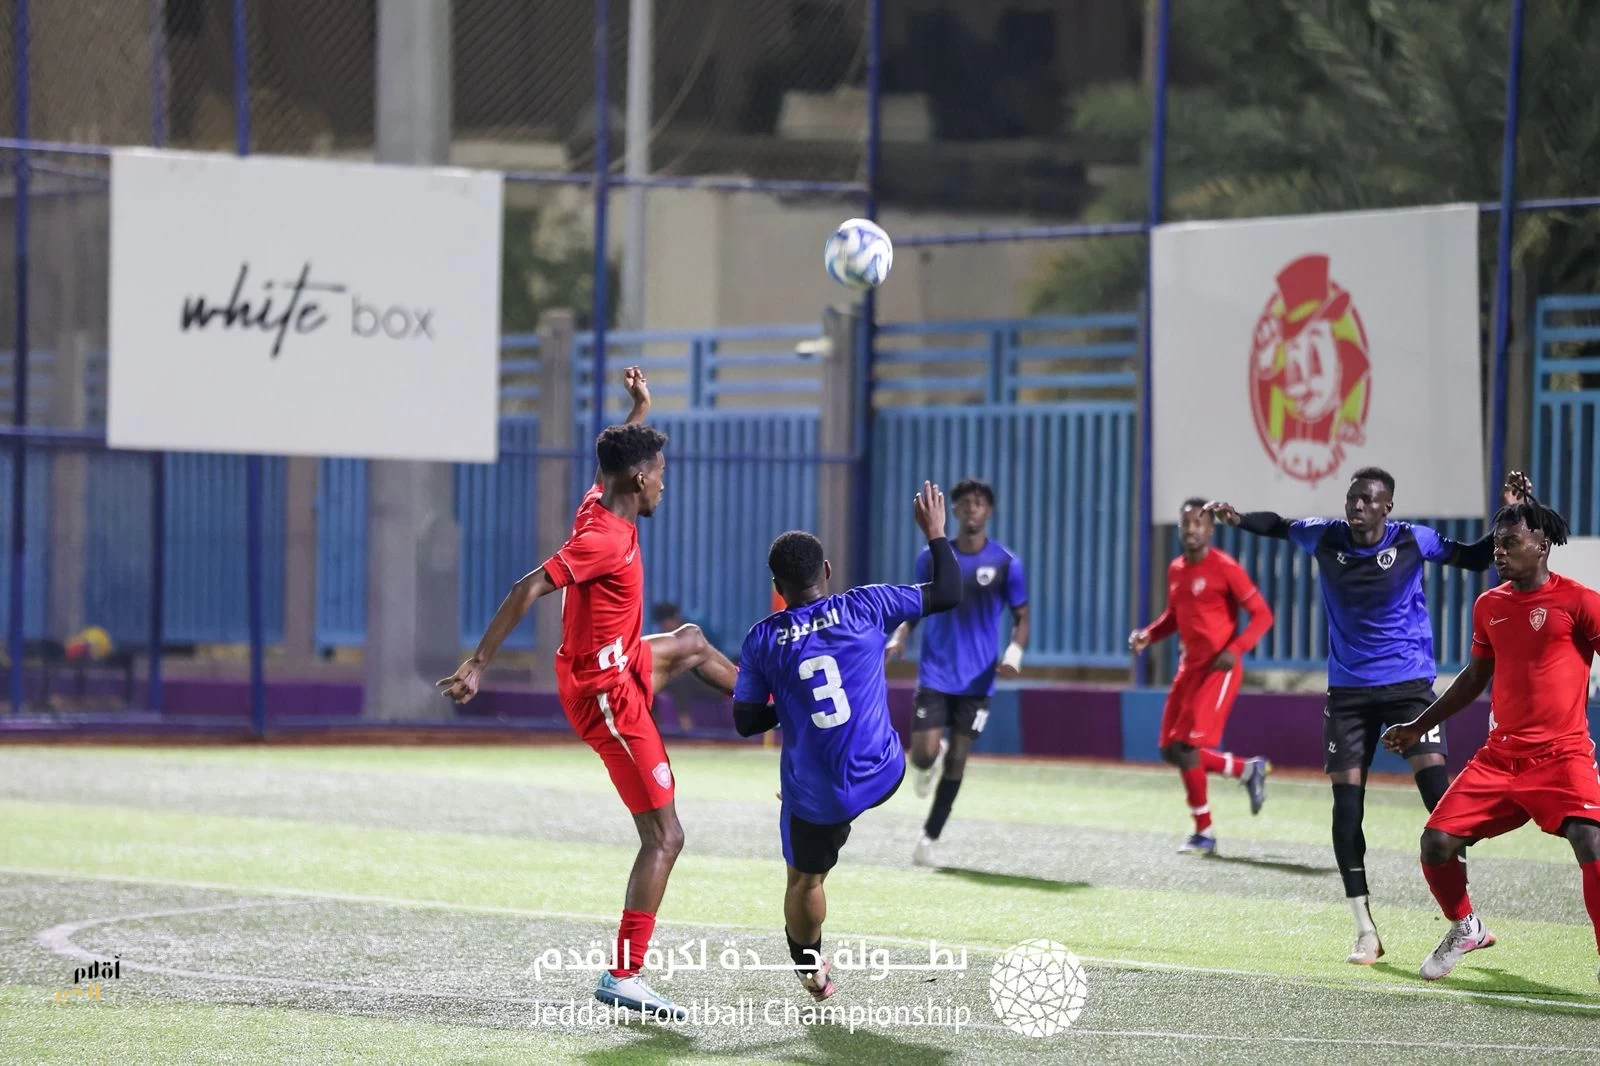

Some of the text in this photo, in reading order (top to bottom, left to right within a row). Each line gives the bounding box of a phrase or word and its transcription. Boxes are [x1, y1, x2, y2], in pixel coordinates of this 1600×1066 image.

[180, 261, 436, 360] white box
[798, 655, 851, 729] 3
